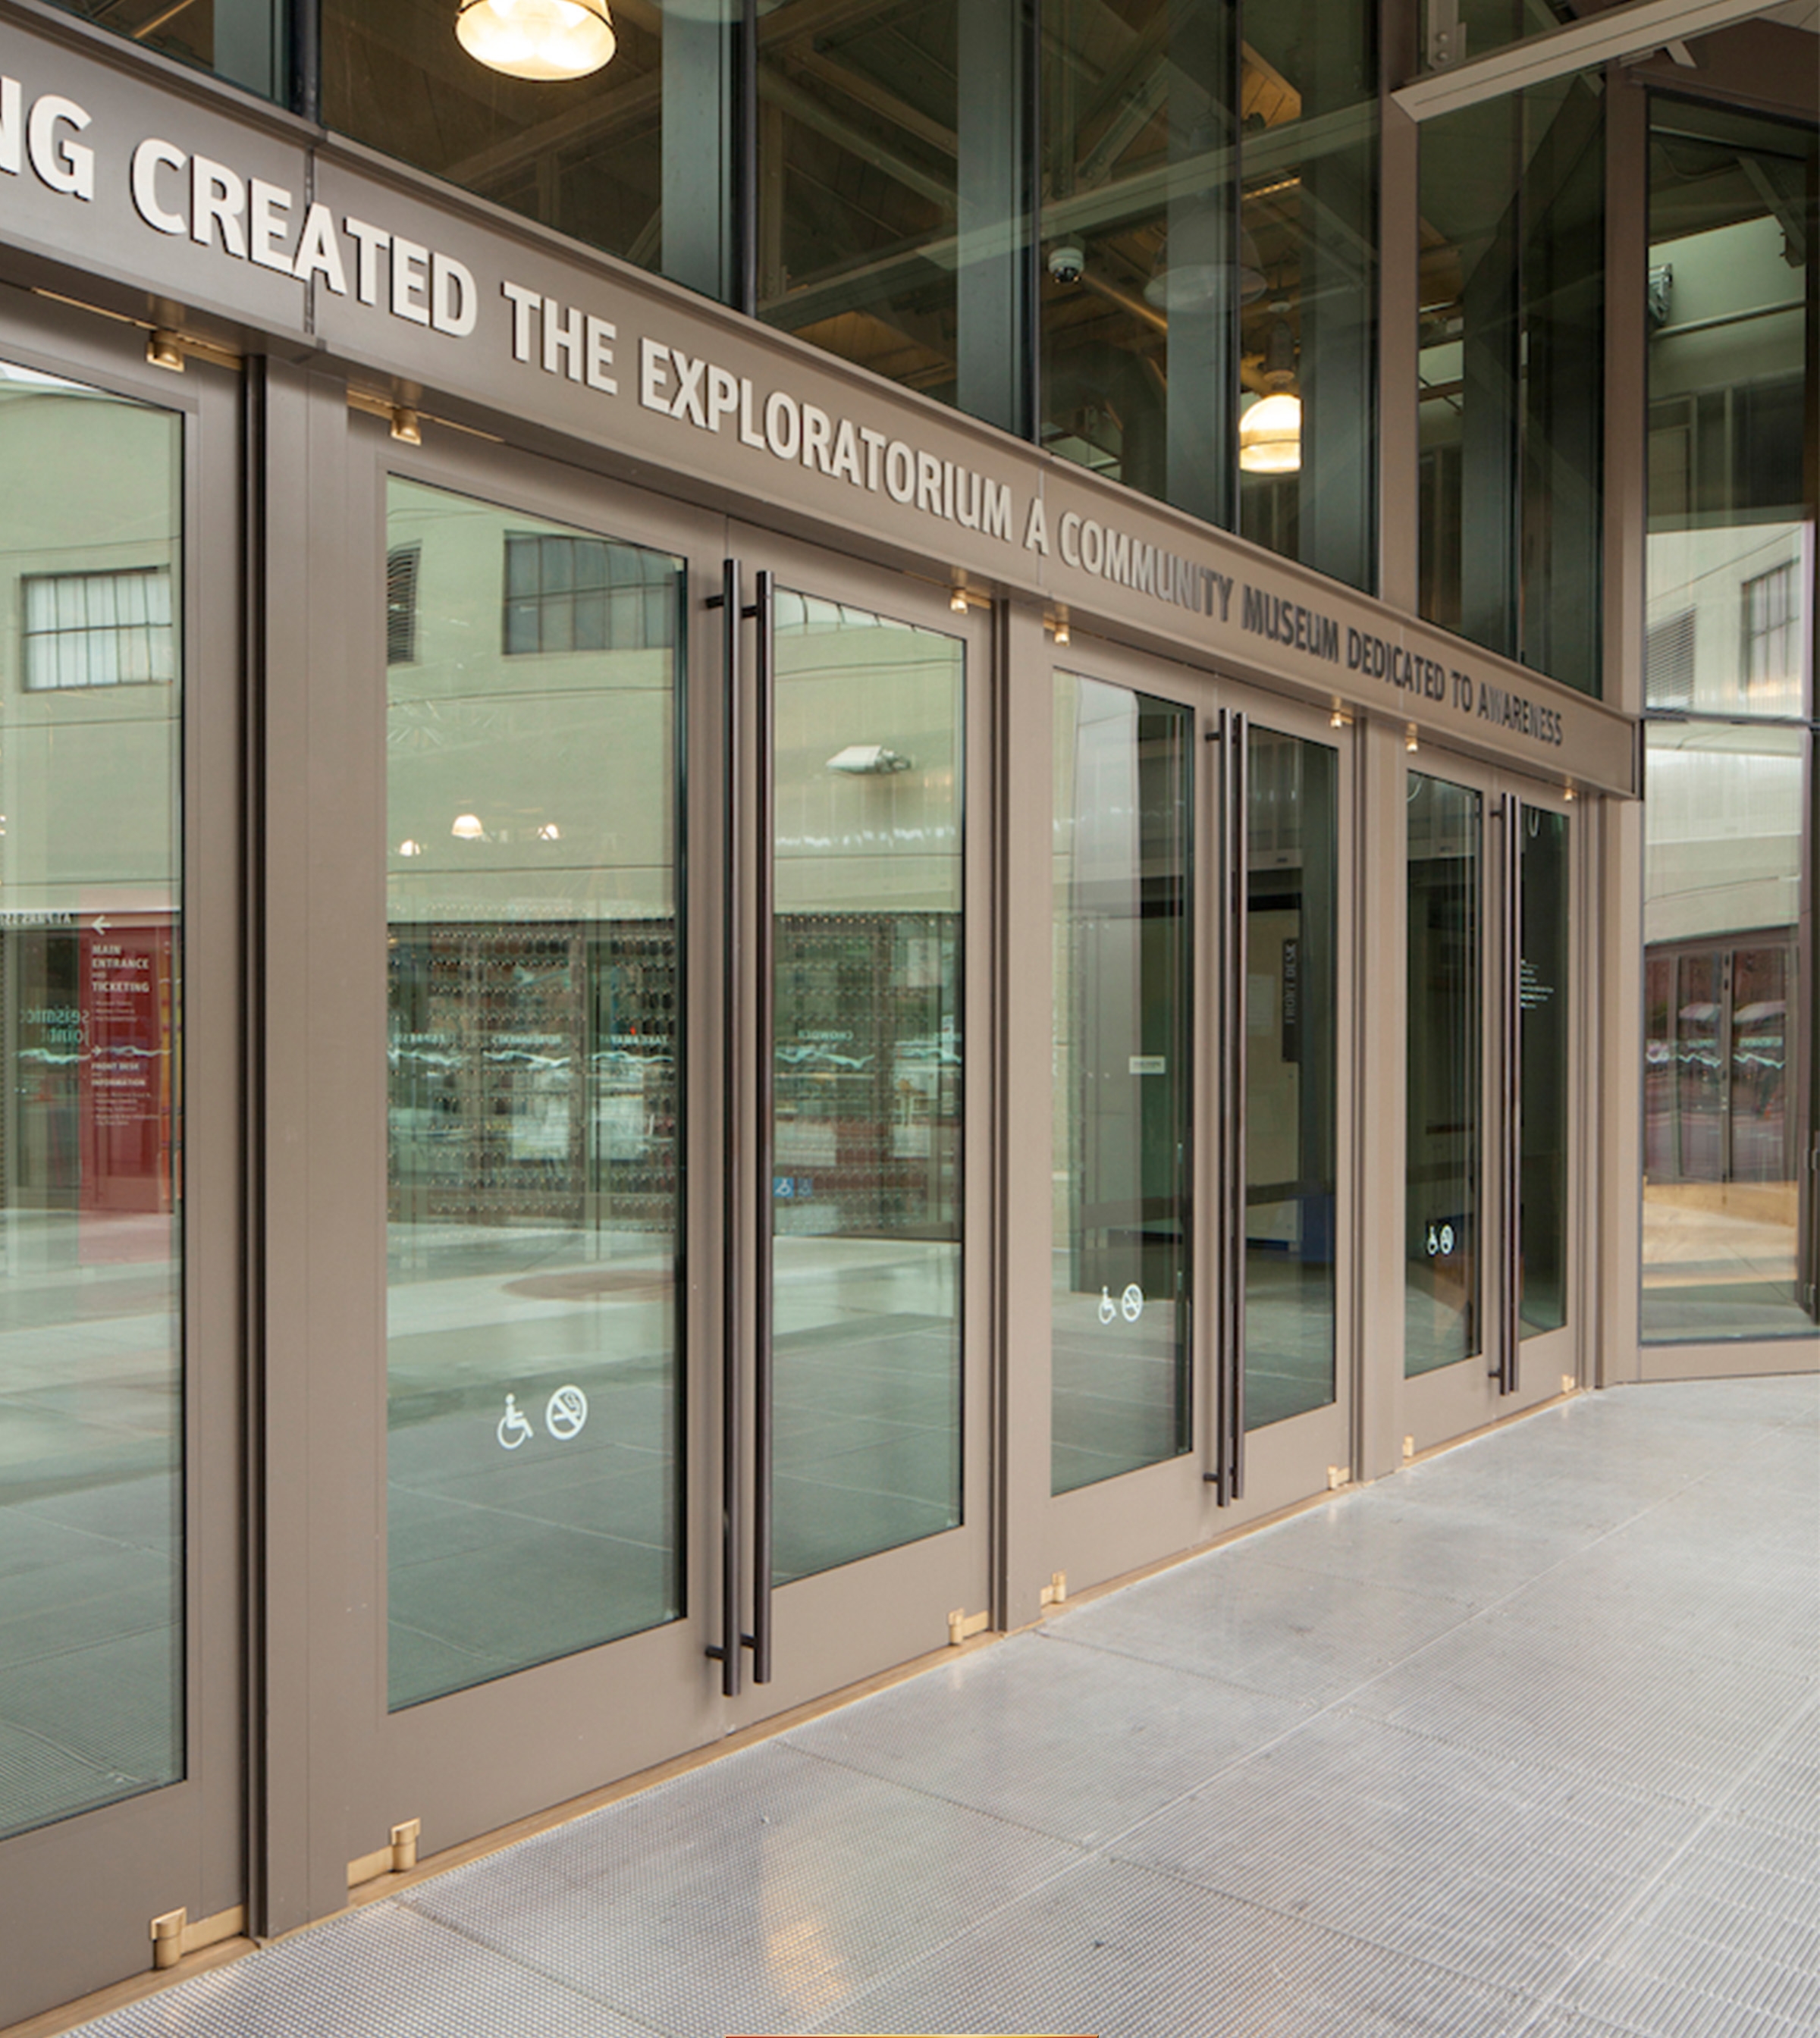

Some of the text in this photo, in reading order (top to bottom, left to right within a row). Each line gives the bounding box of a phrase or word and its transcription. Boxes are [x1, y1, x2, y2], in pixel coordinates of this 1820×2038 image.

[130, 137, 478, 337] CREATED
[501, 281, 618, 396] THE
[639, 337, 1012, 542] EXPLORATORIUM
[1024, 497, 1049, 556] A
[1059, 510, 1234, 622] COMMUNITY
[1241, 583, 1339, 663] MUSEUM
[1346, 626, 1445, 701] DEDICATED
[1451, 670, 1473, 713] TO
[1477, 683, 1563, 747] AWARENESS
[92, 945, 121, 955] MAIN
[92, 958, 149, 969] ENTRANCE
[1284, 943, 1297, 978] DESK
[92, 981, 150, 992] TICKETING
